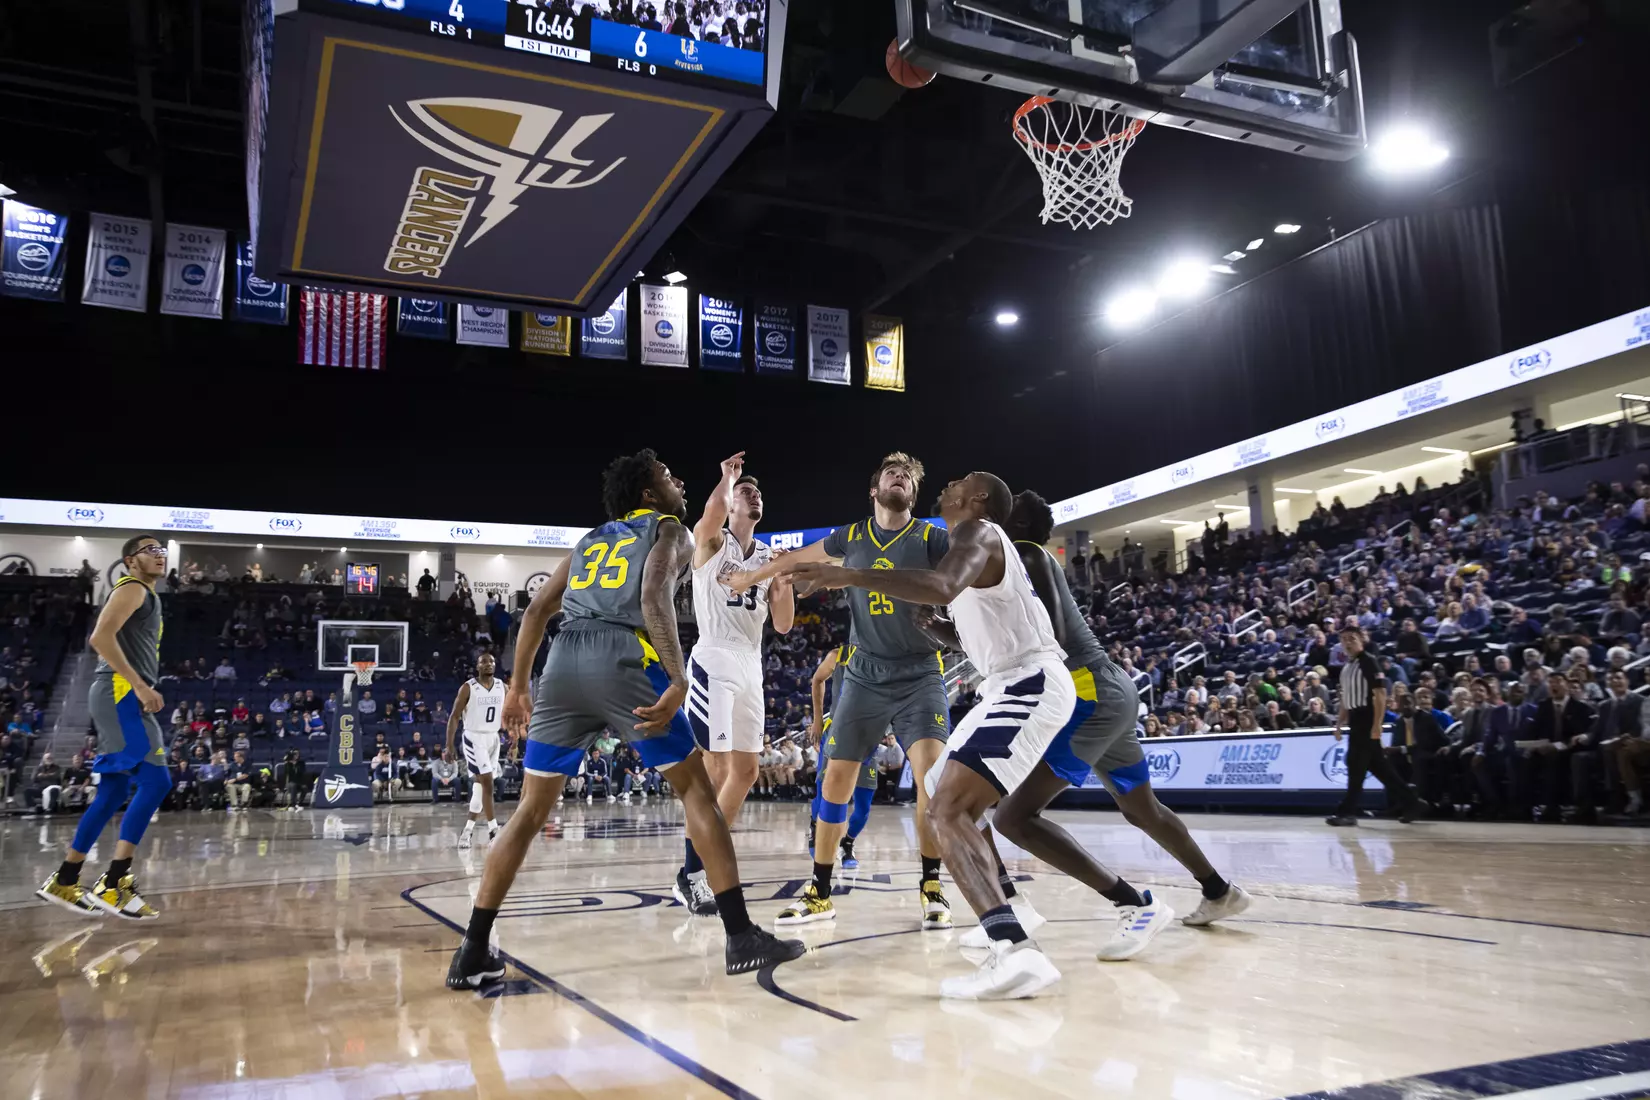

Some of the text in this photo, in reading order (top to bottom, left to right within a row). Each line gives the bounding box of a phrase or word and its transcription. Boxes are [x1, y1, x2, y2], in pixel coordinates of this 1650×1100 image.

[449, 0, 464, 22] 4
[525, 9, 574, 40] 16:46
[430, 21, 472, 40] FLS 1
[520, 39, 580, 59] 1ST HALF
[634, 31, 647, 58] 6
[617, 59, 657, 75] FLS 0
[674, 59, 704, 72] RIVERSIDE
[384, 166, 486, 279] LANCERS
[103, 222, 139, 236] 2015
[178, 232, 212, 244] 2014
[708, 297, 733, 309] 2017
[704, 307, 737, 317] WOMEN'S
[763, 306, 788, 316] 2017
[400, 313, 447, 324] CHAMPIONS
[537, 314, 557, 322] NCAA
[701, 314, 742, 325] BASKETBALL
[816, 312, 840, 323] 2017
[463, 326, 504, 335] CHAMPIONS
[527, 328, 559, 337] DIVISION
[524, 341, 555, 349] RUNNER
[526, 335, 565, 344] NATIONAL
[581, 336, 624, 345] CHAMPIONS
[649, 341, 676, 349] DIVISION
[644, 347, 685, 356] TOURNAMENT
[702, 348, 742, 358] CHAMPIONS
[1518, 353, 1541, 367] FOX
[1321, 419, 1338, 430] FOX
[75, 508, 96, 517] FOX
[169, 510, 210, 519] AM1350
[275, 518, 295, 527] FOX
[360, 520, 397, 529] AM1350
[456, 527, 474, 536] FOX
[770, 532, 803, 549] CBU
[569, 537, 637, 590] 35
[358, 577, 373, 593] 14
[868, 591, 894, 615] 25
[486, 706, 496, 723] 0
[339, 714, 354, 765] CBU
[1219, 743, 1282, 762] AM1350
[1148, 754, 1173, 770] FOX
[1222, 762, 1270, 773] RIVERSIDE
[1149, 770, 1170, 778] PORTS
[1204, 773, 1284, 785] SAN BERNARDINO
